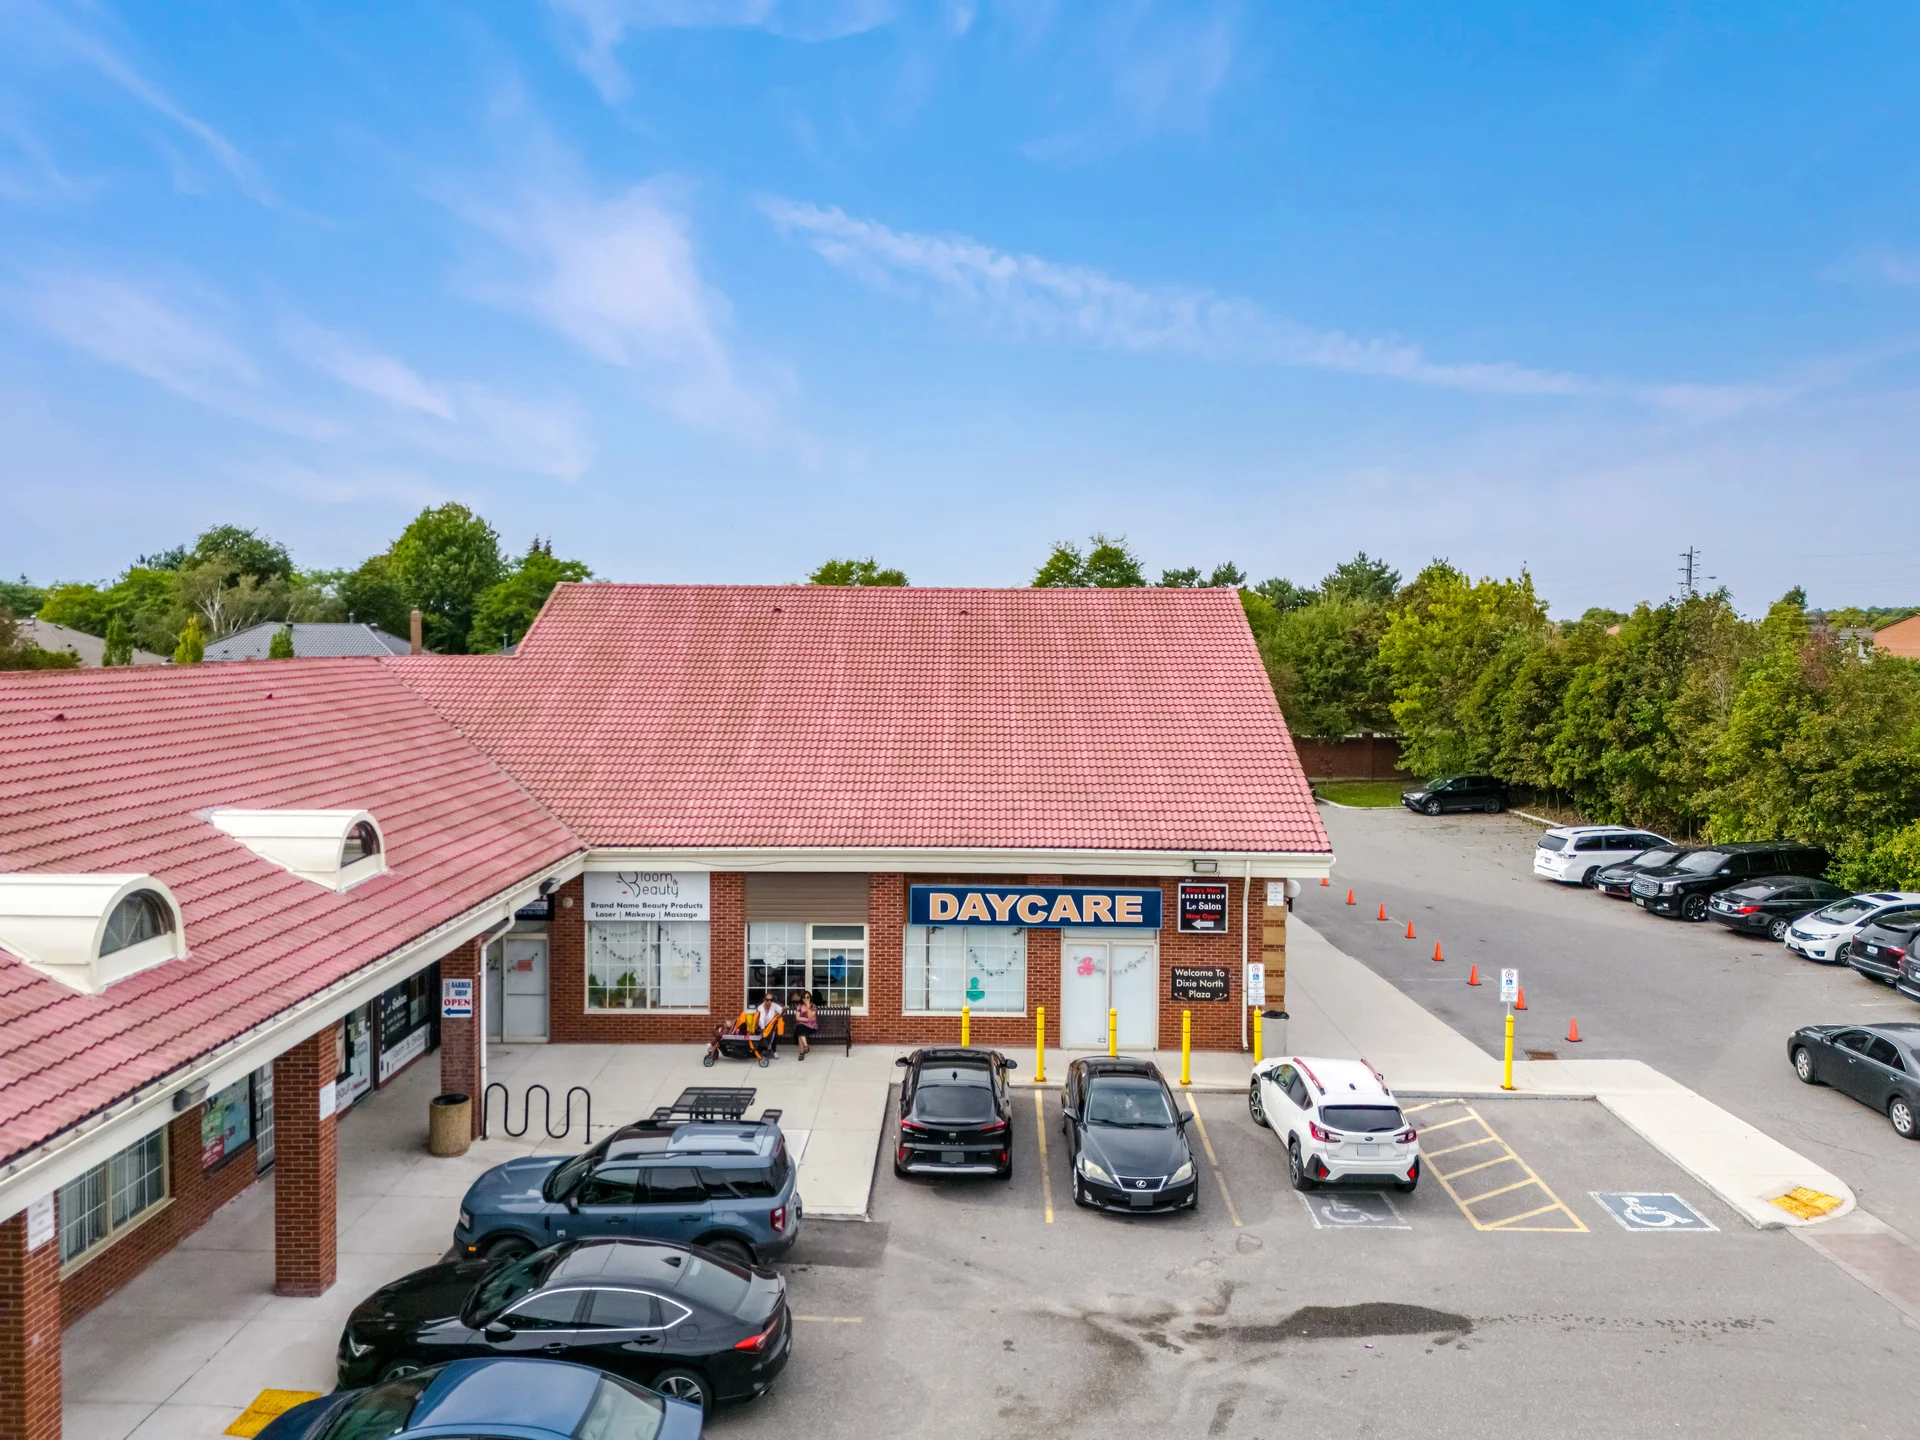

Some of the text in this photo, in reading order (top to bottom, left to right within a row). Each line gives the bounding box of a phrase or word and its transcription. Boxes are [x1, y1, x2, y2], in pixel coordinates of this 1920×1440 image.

[642, 902, 669, 910] Beauty
[929, 892, 1143, 924] DAYCARE
[1186, 901, 1222, 911] Le Salon
[624, 911, 656, 919] Makeup
[663, 911, 698, 919] Massage
[1174, 968, 1225, 977] Welcome To
[1176, 979, 1224, 988] Dixie North
[1188, 989, 1211, 999] Plaza
[443, 998, 471, 1006] OPEN
